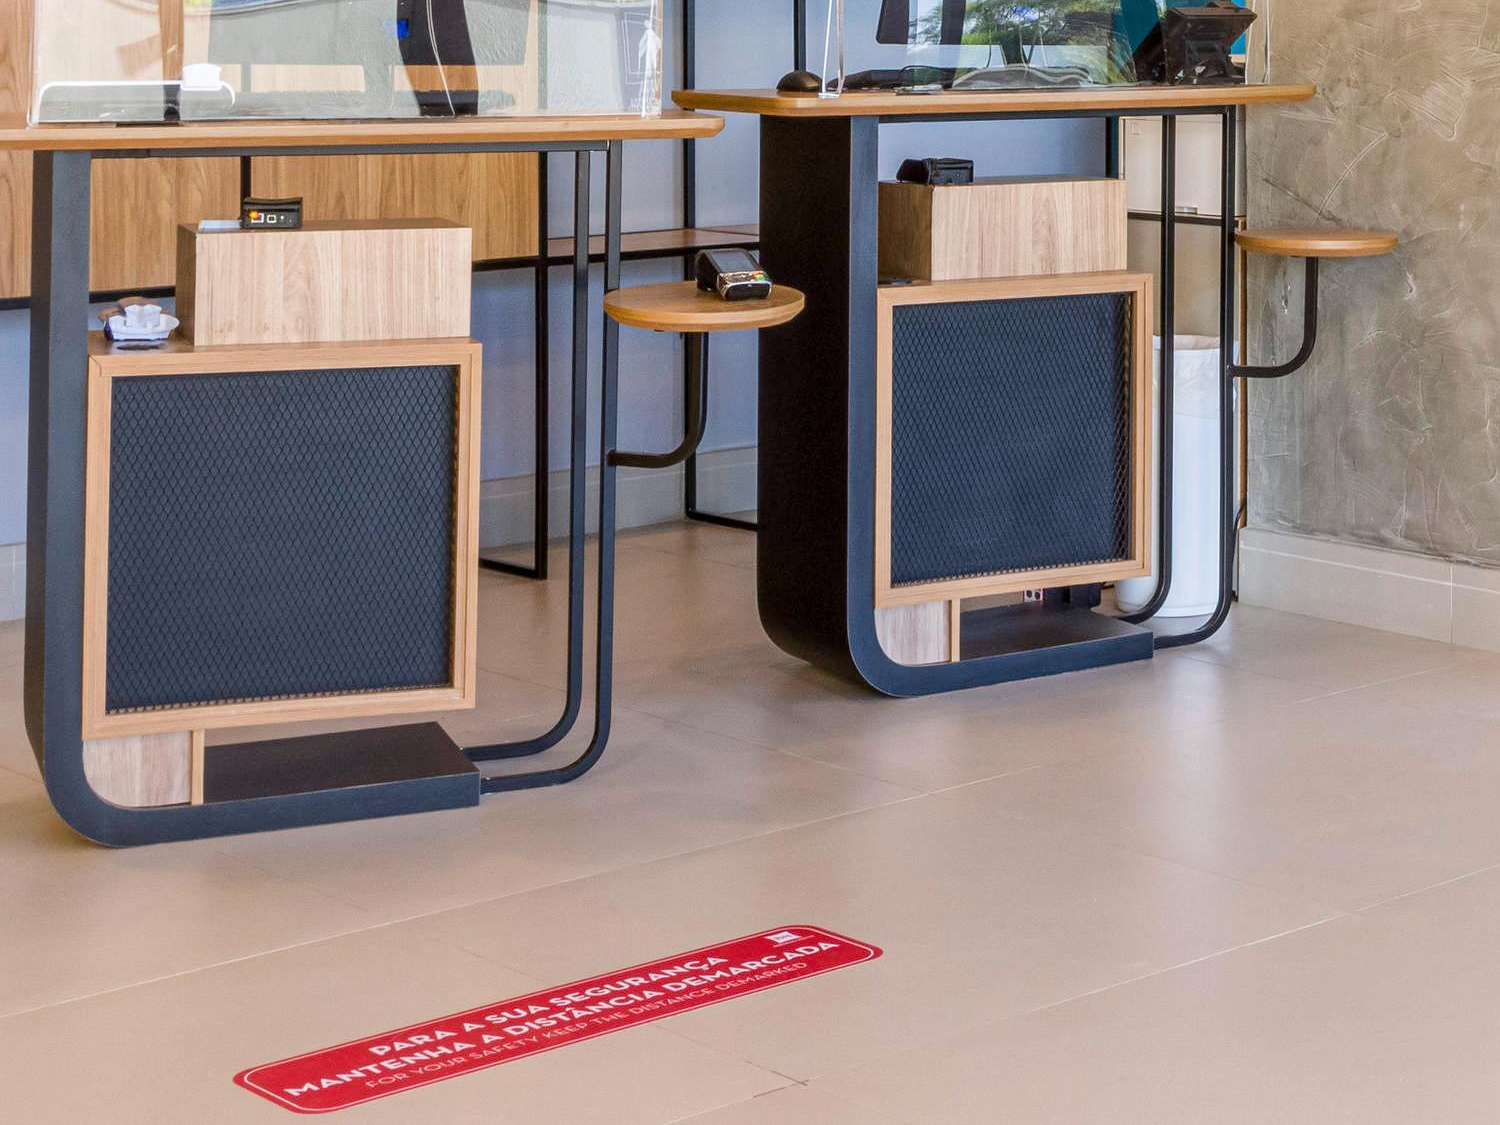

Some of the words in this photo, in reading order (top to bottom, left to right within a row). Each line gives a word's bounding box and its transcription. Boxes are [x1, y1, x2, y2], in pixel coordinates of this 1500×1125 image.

[284, 1041, 477, 1097] MANTENHA
[481, 1033, 505, 1044] A
[503, 990, 665, 1035] DISTÂNCIA
[662, 941, 840, 992] DEMARCADA
[366, 1073, 411, 1088] FOR
[409, 1056, 468, 1075] YOUR
[468, 1035, 540, 1060] SAFETY
[542, 1021, 589, 1039] KEEP
[590, 1012, 630, 1024] THE
[628, 987, 716, 1014] DISTANCE
[714, 961, 808, 991] DEMARKED
[368, 1030, 458, 1055] PARA
[463, 1022, 486, 1032] A
[485, 1004, 550, 1024] SUA
[549, 956, 729, 1007] SEGURANÇA
